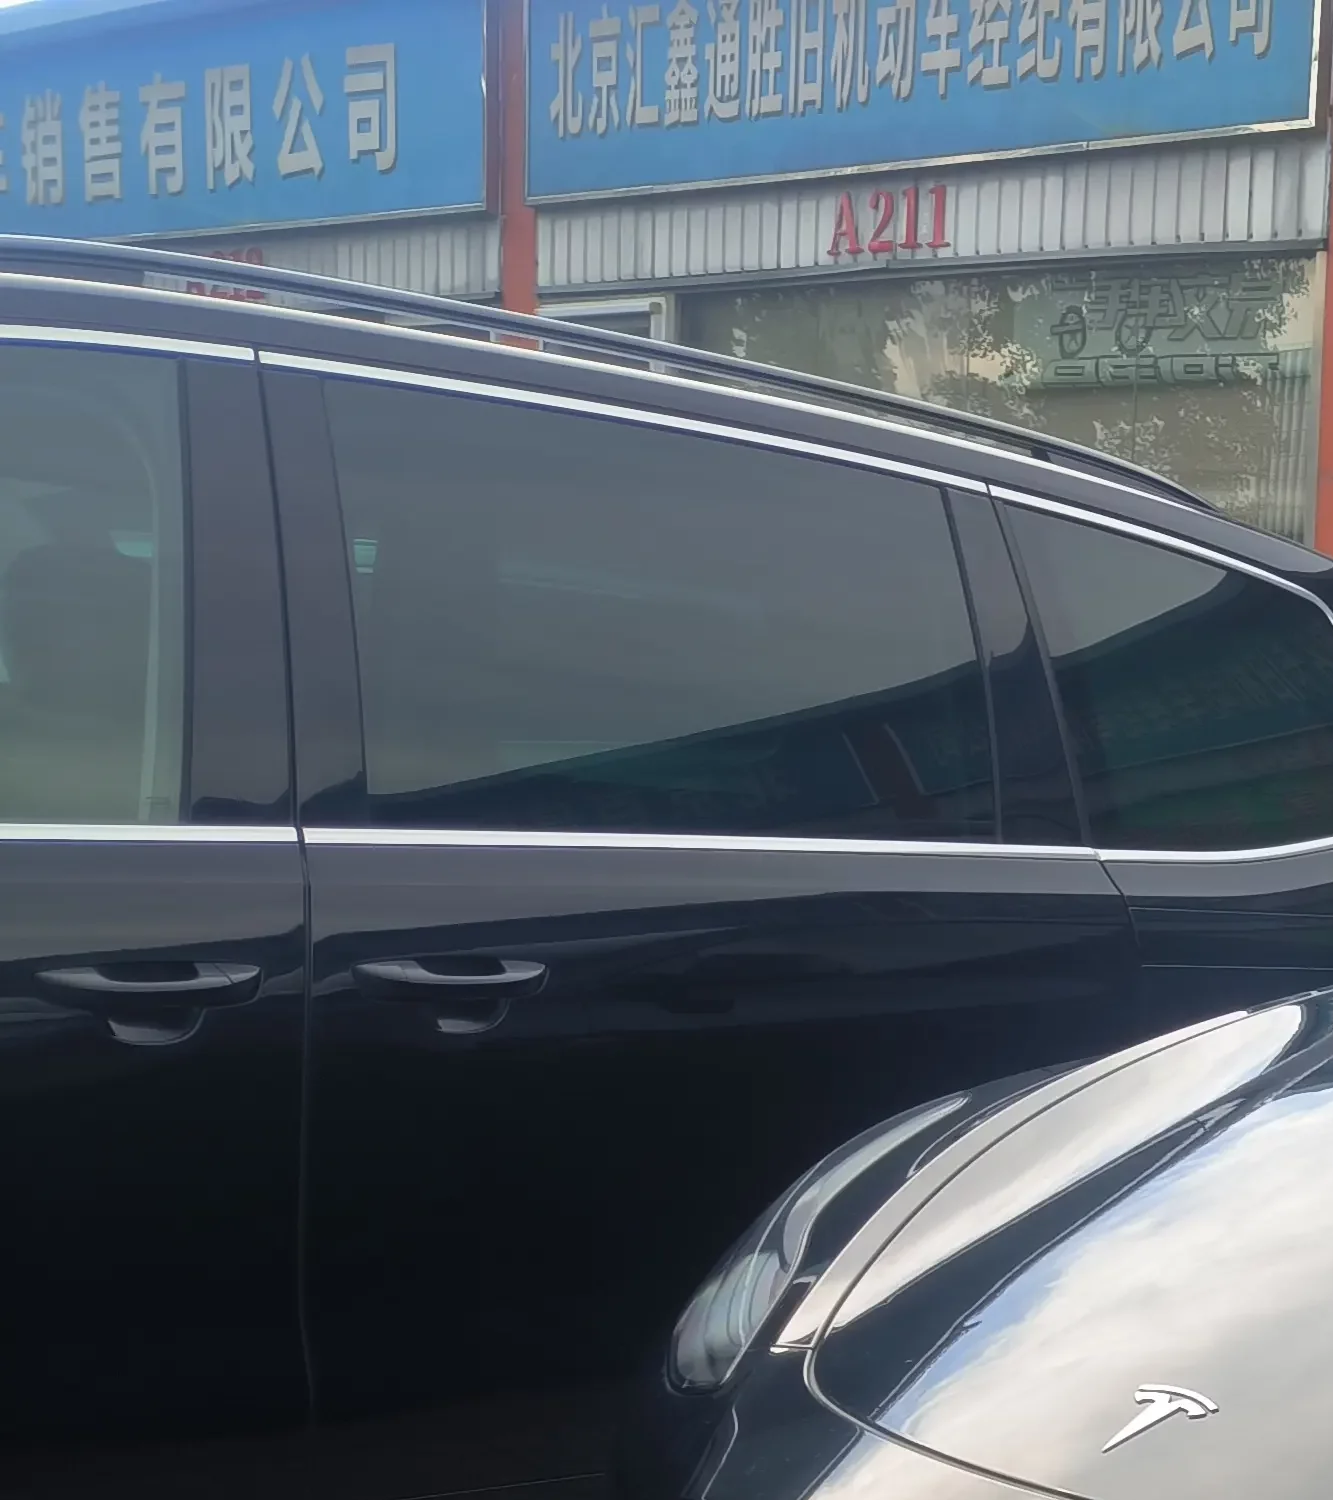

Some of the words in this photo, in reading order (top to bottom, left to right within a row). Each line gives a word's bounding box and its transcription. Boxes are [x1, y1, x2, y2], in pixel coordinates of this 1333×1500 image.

[0, 42, 397, 206] 销售有限公司
[827, 184, 951, 257] A211
